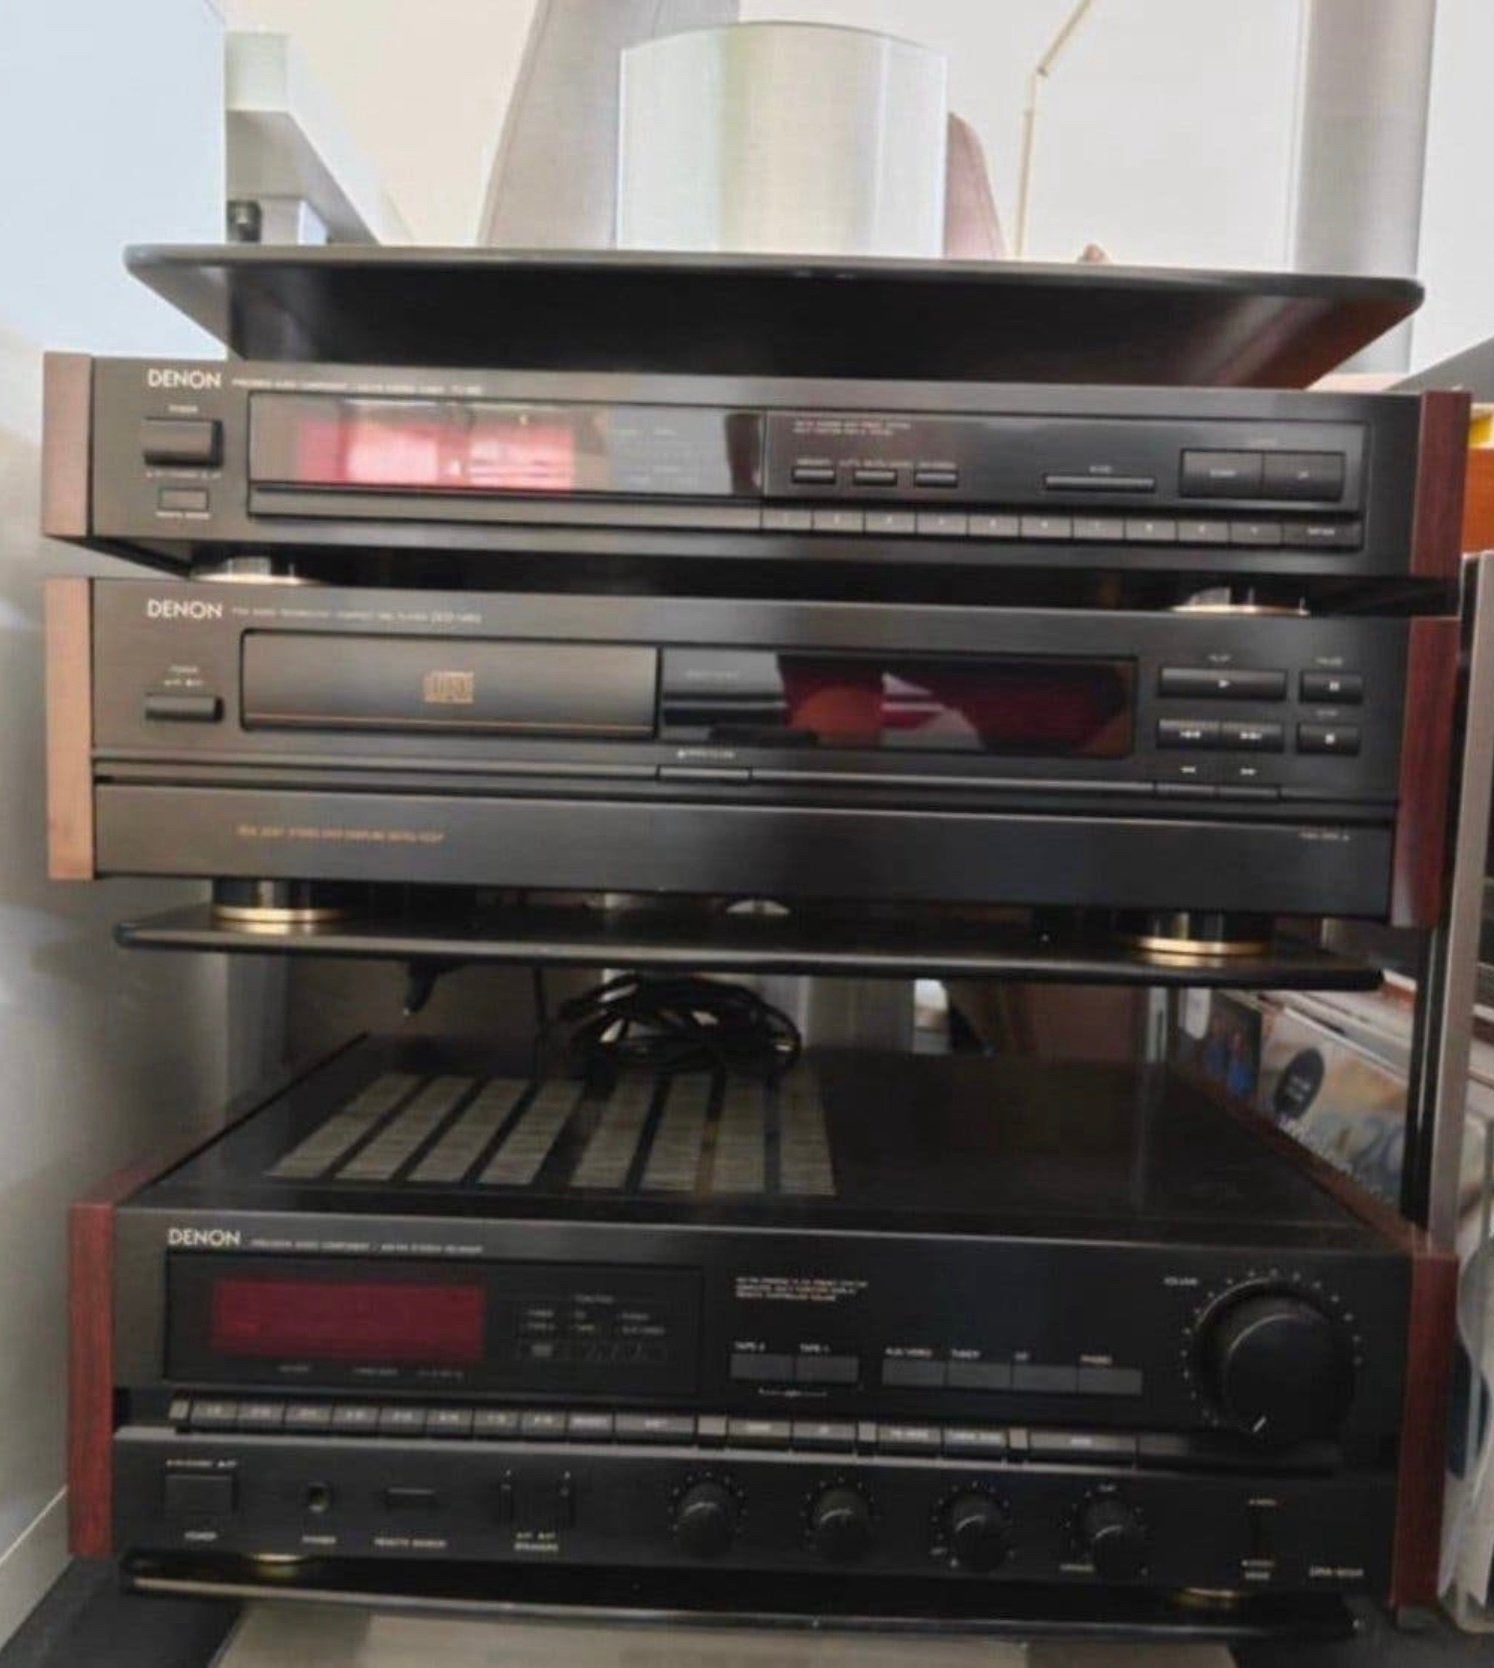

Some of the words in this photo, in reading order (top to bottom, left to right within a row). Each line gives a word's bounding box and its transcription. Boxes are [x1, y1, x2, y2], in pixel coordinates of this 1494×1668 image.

[147, 368, 222, 389] DENON
[147, 599, 223, 619] DENON
[168, 1228, 241, 1246] DENON
